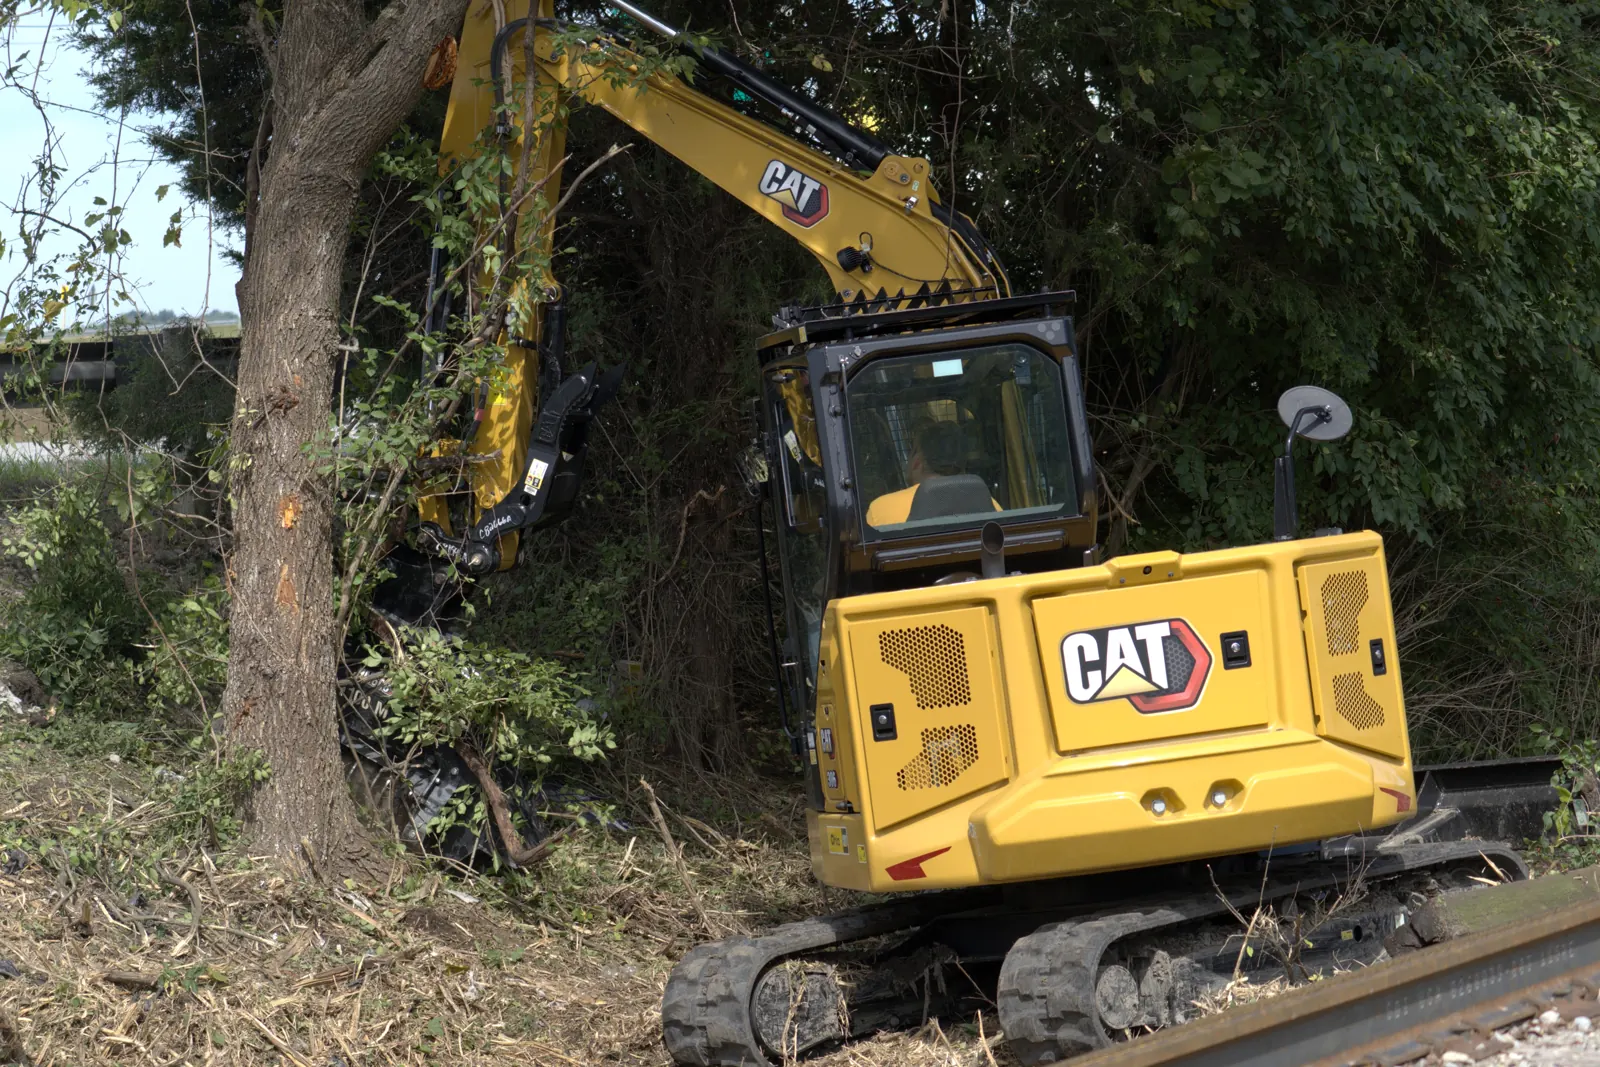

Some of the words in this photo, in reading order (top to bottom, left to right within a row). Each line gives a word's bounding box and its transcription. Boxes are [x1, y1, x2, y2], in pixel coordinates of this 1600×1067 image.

[759, 160, 821, 213] CAT
[1062, 621, 1171, 701] CAT
[820, 728, 833, 753] CAT
